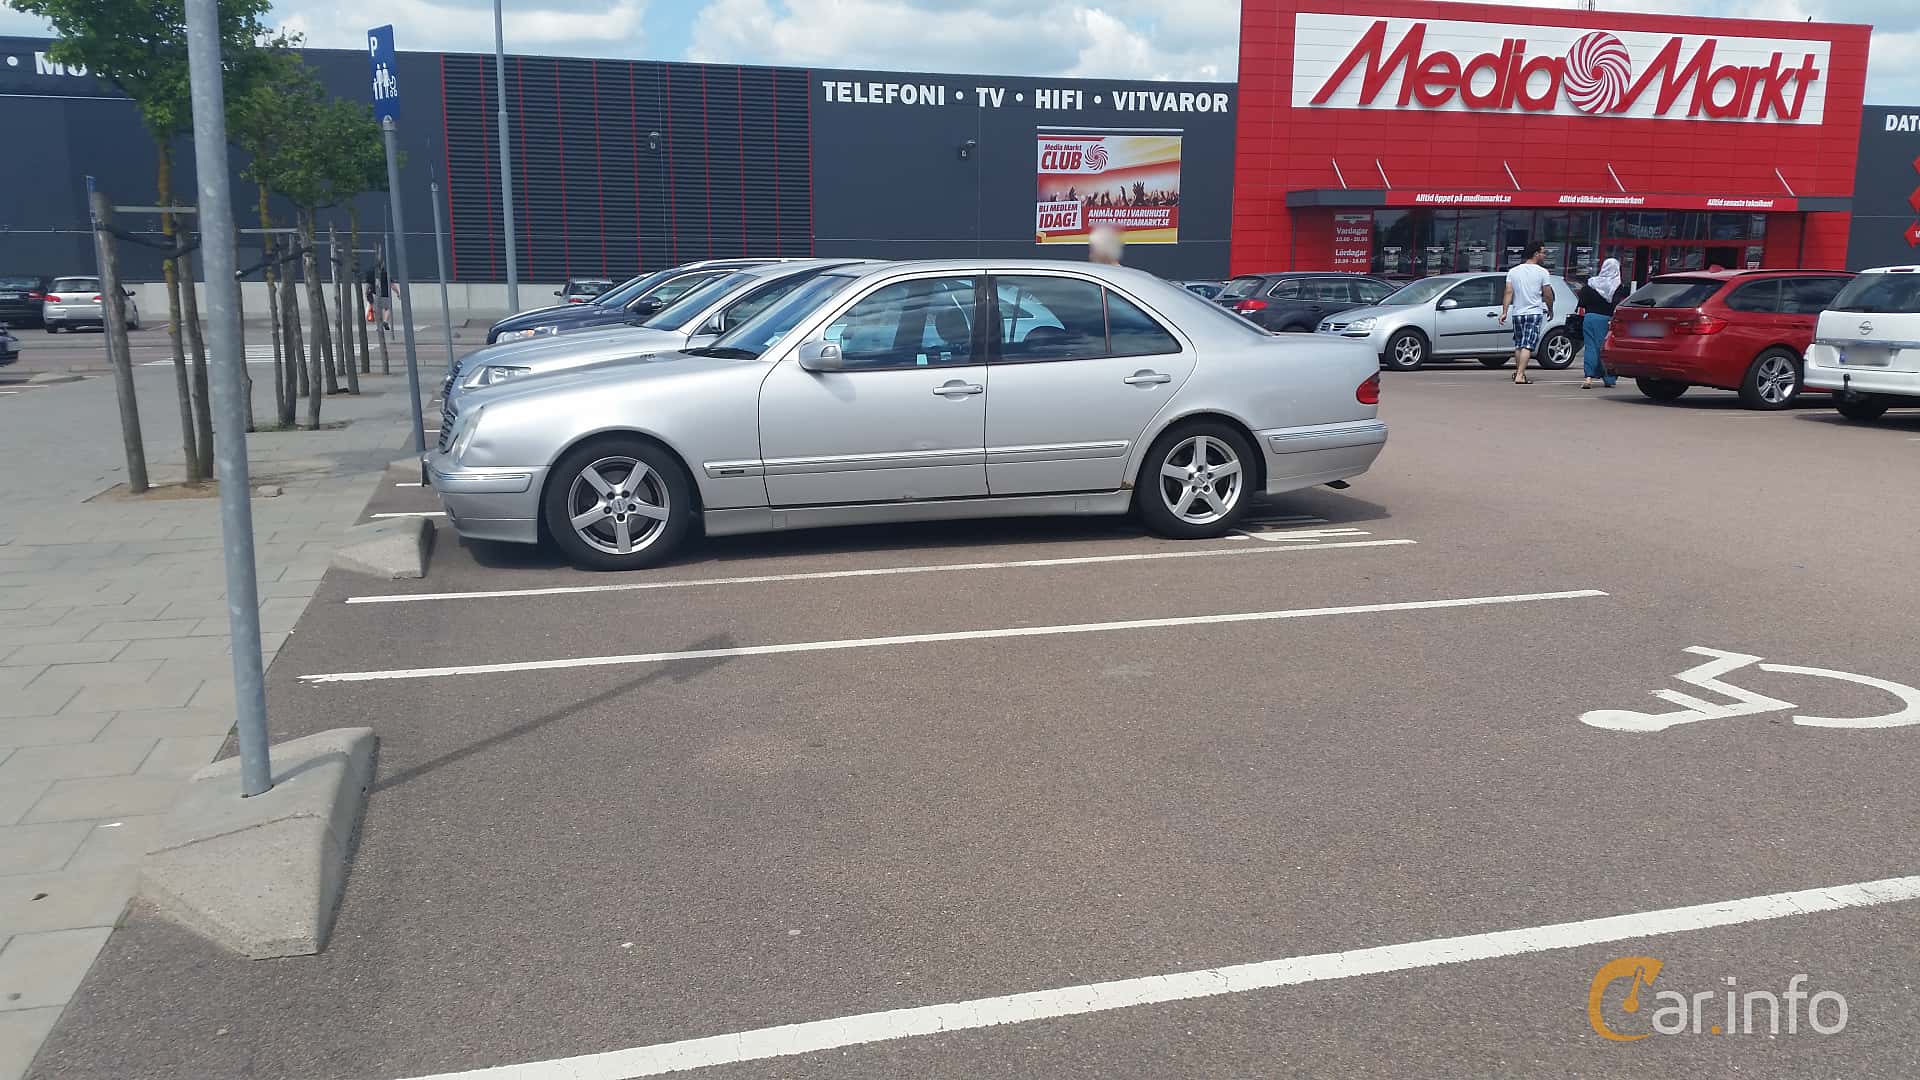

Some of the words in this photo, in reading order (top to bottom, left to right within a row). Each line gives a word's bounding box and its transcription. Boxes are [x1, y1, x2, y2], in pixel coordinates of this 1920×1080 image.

[370, 36, 378, 57] P
[1310, 21, 1567, 110] Media
[1612, 37, 1819, 119] Markt
[822, 81, 945, 105] TELEFONI
[975, 87, 1005, 108] TV
[1035, 89, 1083, 111] HIFI
[1112, 91, 1229, 113] VITVAROR
[1885, 114, 1920, 132] DAT
[1044, 143, 1063, 151] Media
[1041, 151, 1083, 170] CLUB
[1049, 203, 1078, 211] MEDLEM
[1088, 208, 1114, 218] ANMÄL
[1114, 209, 1128, 217] DIG
[1130, 209, 1170, 218] VARUHUSET
[1039, 212, 1078, 229] IDAG!
[1336, 227, 1368, 235] Vardagar
